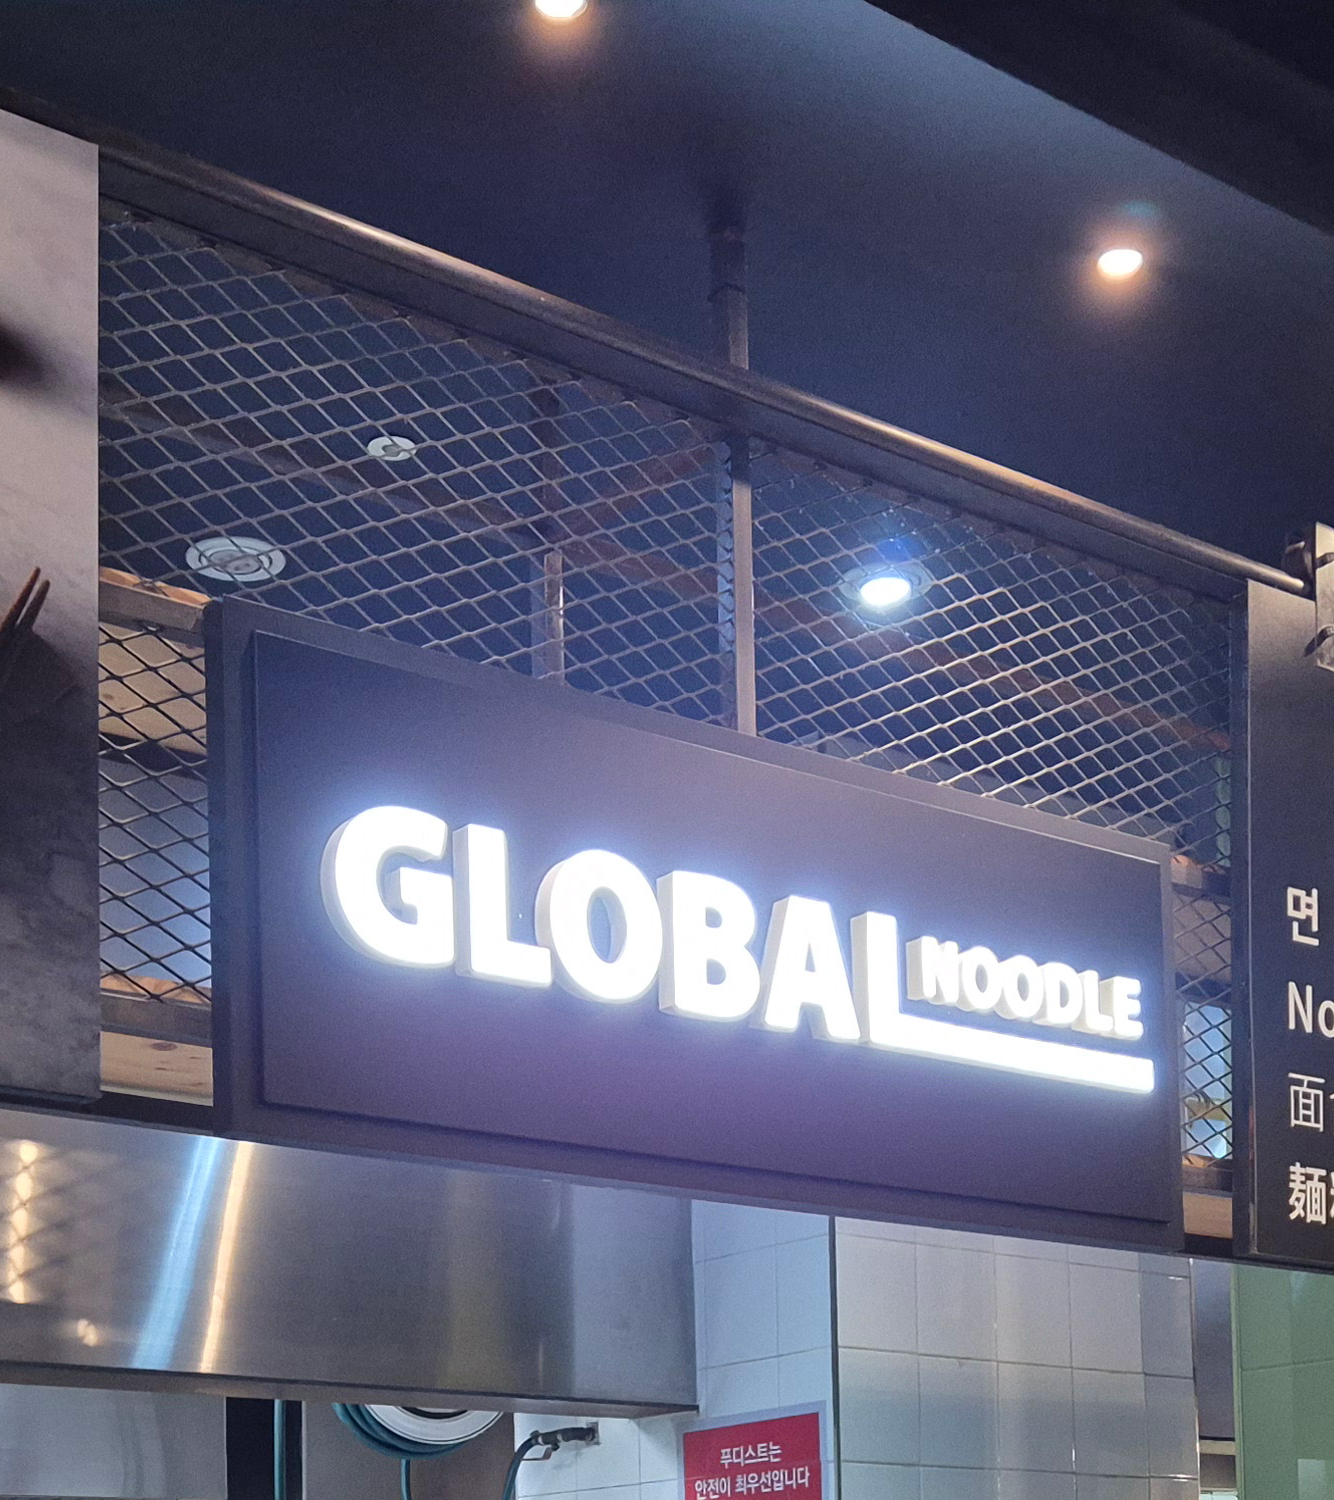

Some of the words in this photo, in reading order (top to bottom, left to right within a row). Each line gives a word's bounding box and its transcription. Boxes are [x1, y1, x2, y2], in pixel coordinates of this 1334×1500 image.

[320, 804, 909, 1050] GLOBAL
[906, 936, 1145, 1039] NOODLE
[1286, 886, 1320, 947] 면
[720, 1441, 782, 1469] 푸디스트는
[694, 1477, 731, 1500] 안전이
[735, 1466, 810, 1497] 최우선입니다
